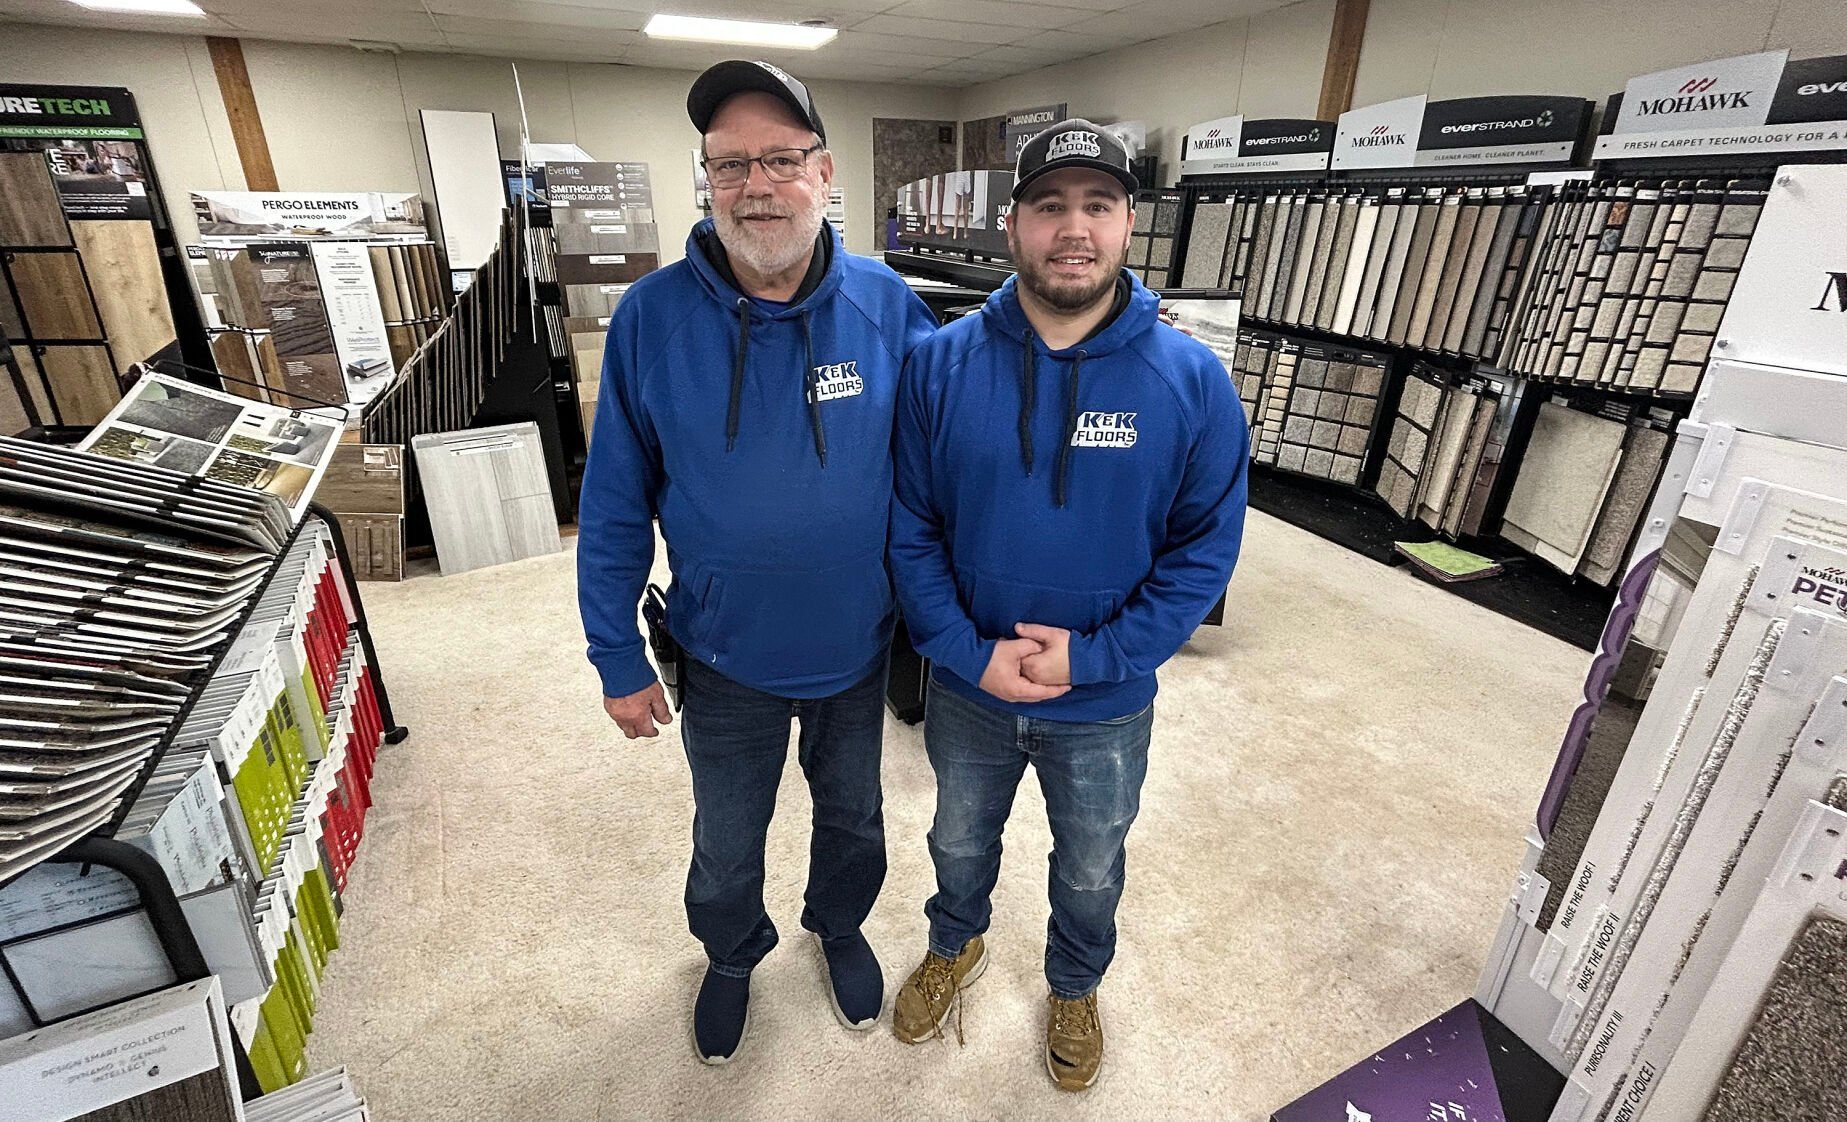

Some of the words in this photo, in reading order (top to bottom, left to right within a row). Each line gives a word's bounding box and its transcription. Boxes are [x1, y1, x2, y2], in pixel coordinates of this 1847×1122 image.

[1637, 91, 1753, 116] MOHAWK
[1013, 111, 1055, 125] MANNINGTON
[1441, 119, 1534, 134] everSTRAND
[1194, 137, 1233, 150] MOHAWK
[1245, 135, 1307, 146] everSTRAND
[1352, 134, 1406, 147] MOHAWK
[1624, 141, 1658, 150] FRESH
[1661, 139, 1703, 147] CARPET
[1709, 133, 1793, 146] TECHNOLOGY
[1797, 132, 1824, 141] FOR
[1051, 143, 1099, 157] FLOORS
[548, 166, 580, 175] Everlife
[550, 185, 611, 193] SMITHCLIFFS
[262, 200, 303, 210] PERGO
[304, 200, 359, 210] ELEMENTS
[1078, 430, 1137, 444] FLOORS
[1561, 905, 1576, 928] RAISE
[1570, 891, 1583, 908] THE
[1577, 864, 1594, 895] WOOF
[1577, 966, 1595, 992] RAISE
[1588, 948, 1602, 967] THE
[1596, 920, 1617, 951] WOOF
[1609, 912, 1620, 922] II
[85, 1047, 118, 1063] SMART
[121, 1025, 186, 1051] COLLECTION
[1584, 1017, 1619, 1077] PURRSONALITY
[1613, 1010, 1624, 1022] III
[1628, 1065, 1654, 1103] CHOICE
